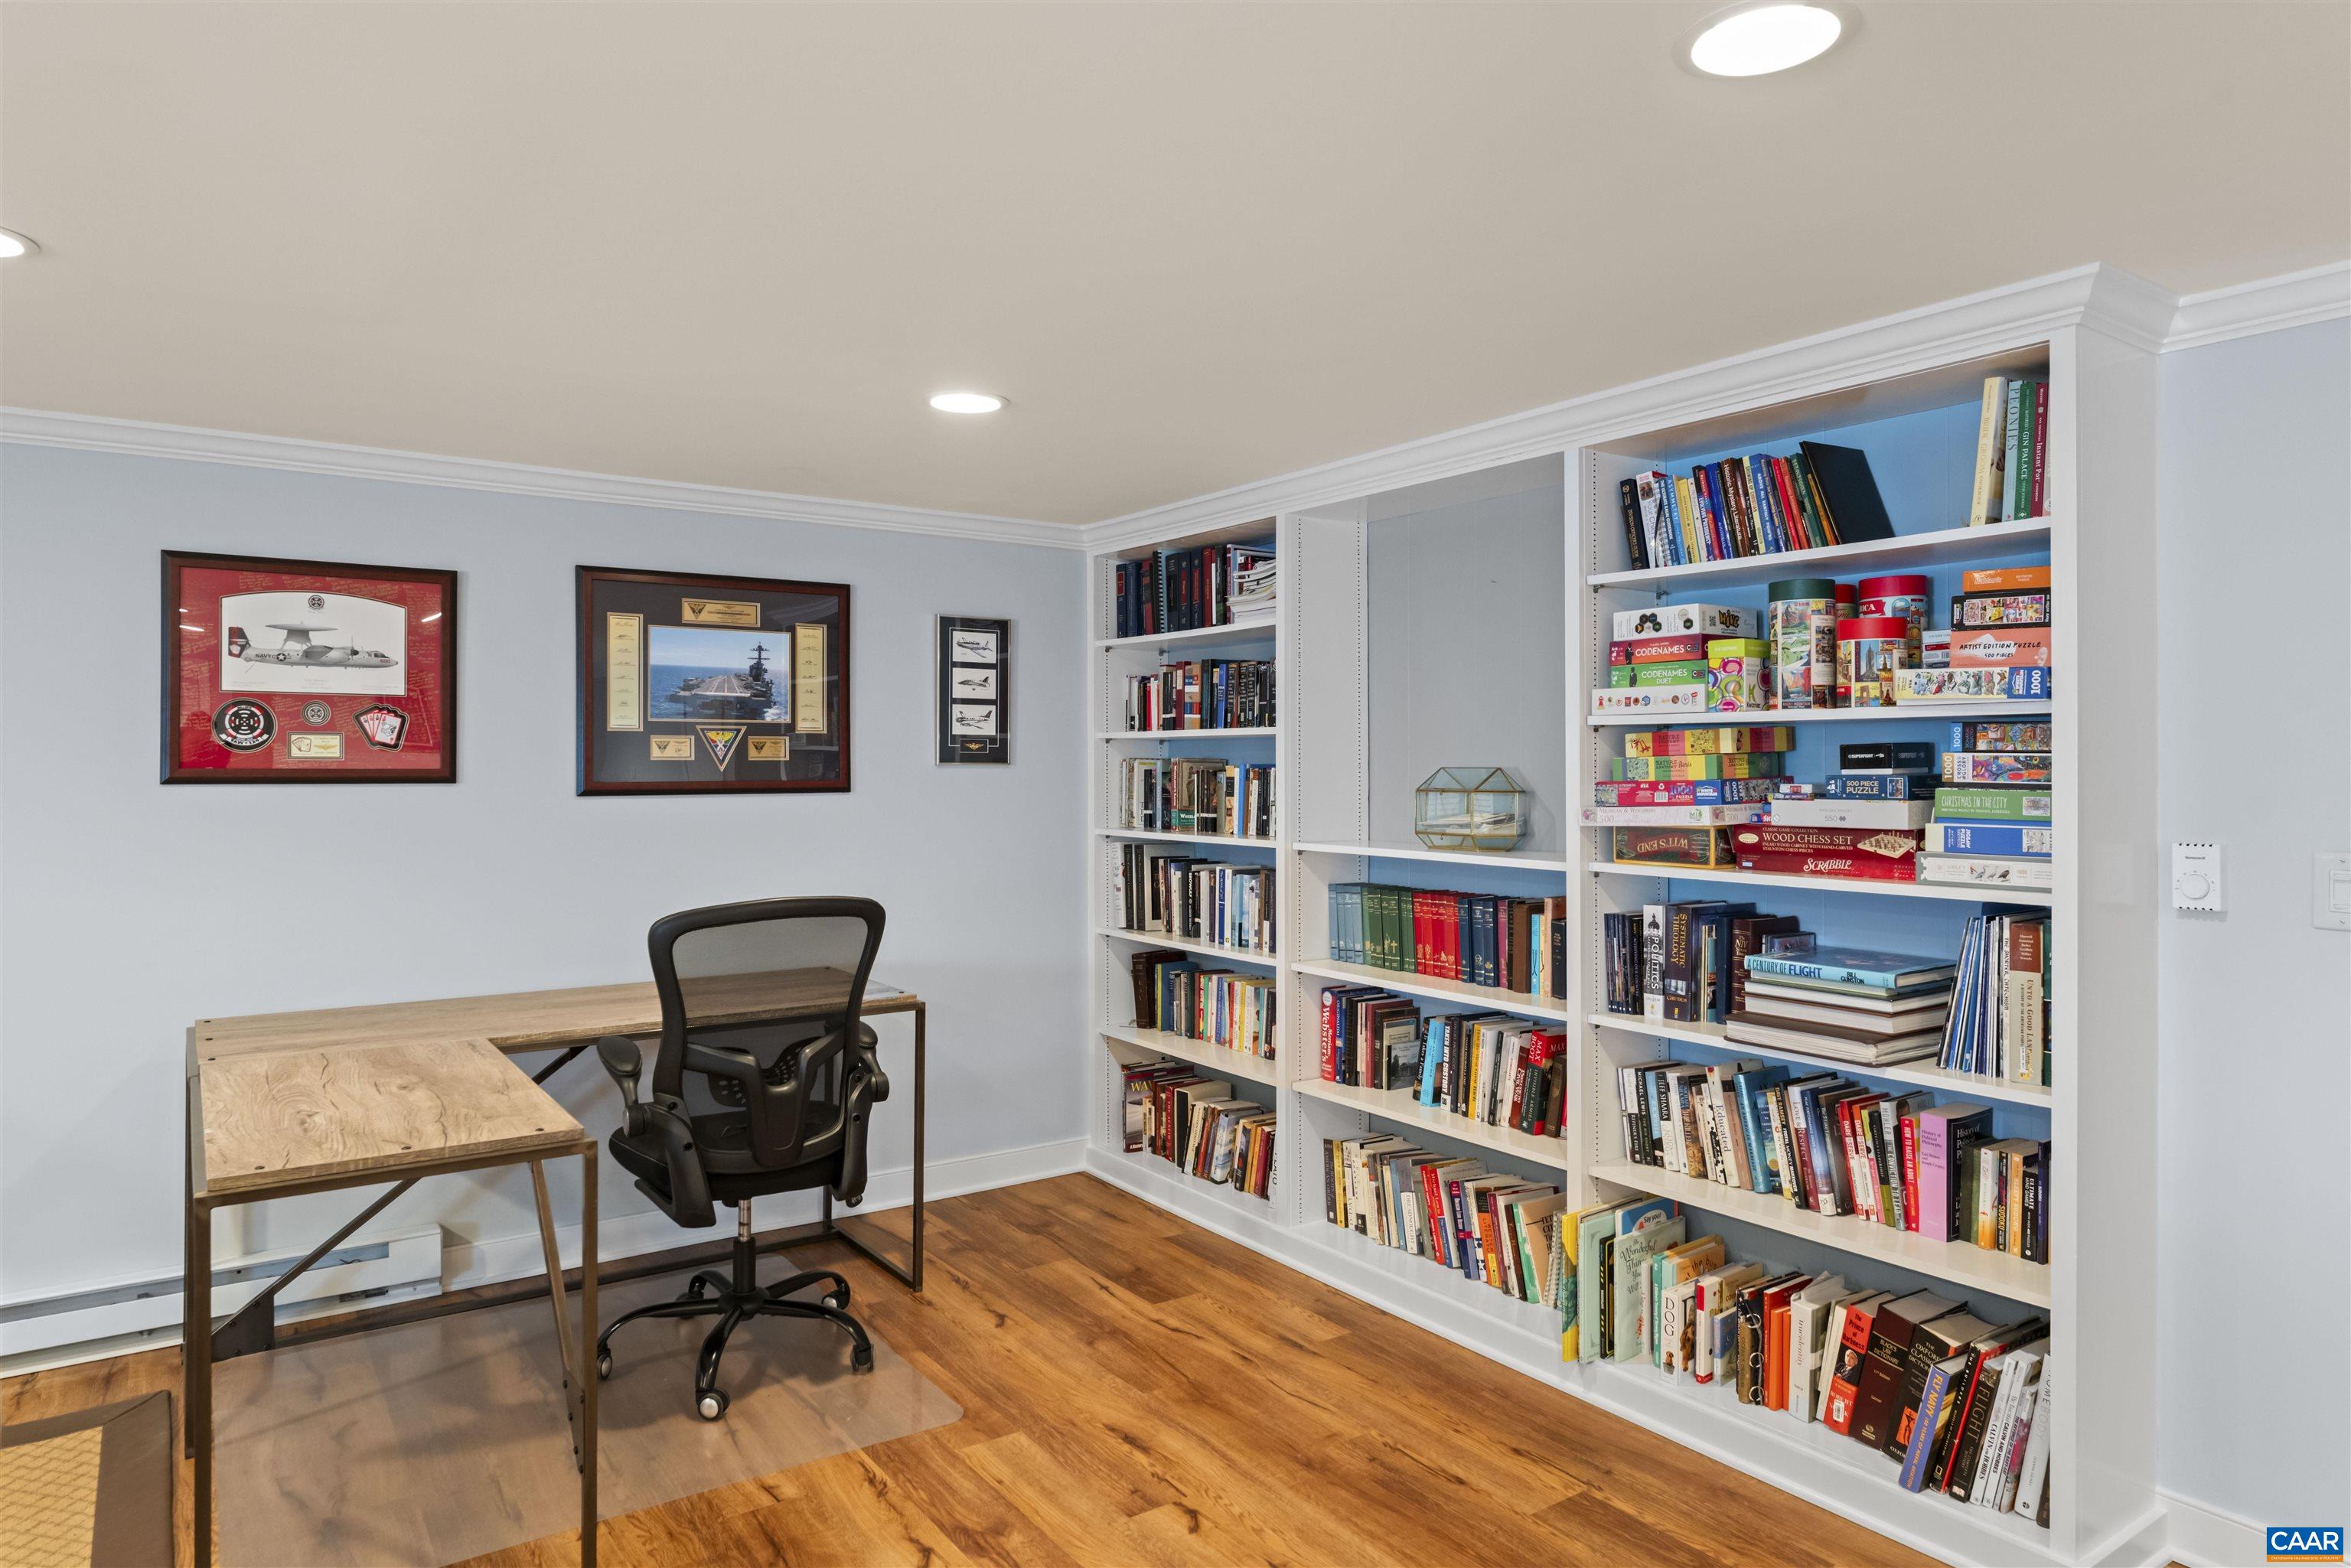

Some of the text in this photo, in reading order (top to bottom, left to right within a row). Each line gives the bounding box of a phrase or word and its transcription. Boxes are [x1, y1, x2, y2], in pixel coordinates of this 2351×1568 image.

[2007, 388, 2020, 451] PEONIES
[1668, 480, 1678, 520] ASYMMETRY
[1702, 518, 1710, 545] PRESIDENCY
[1733, 511, 1742, 540] Literature
[1635, 644, 1684, 657] CODENAMES
[1642, 669, 1687, 679] CODENAMES
[2031, 670, 2042, 695] 1000
[1669, 785, 1694, 796] 1000
[1942, 796, 2007, 808] CHRISTMAS IN THE CITY
[1599, 814, 1614, 823] 500
[1637, 836, 1688, 852] WIT'S END
[1762, 833, 1853, 845] WOOD CHESS SET
[1803, 858, 1853, 872] SCRABBLE
[1671, 916, 1679, 963] THEOLOGY
[1735, 939, 1747, 948] NIV
[1747, 959, 1822, 979] A CENTURY OF FLIGHT
[1841, 976, 1865, 985] GUNSTON
[1534, 1041, 1543, 1061] MAX
[1660, 1094, 1668, 1119] SHAARA
[1716, 1105, 1731, 1152] Educated
[1882, 1108, 1892, 1135] MOHLER
[1854, 1120, 1867, 1159] DARE SERVE
[1922, 1139, 1942, 1148] Philosophy
[1957, 1128, 1974, 1139] History
[1798, 1129, 1808, 1162] RESPECT
[1846, 1142, 1854, 1160] SERVE
[1746, 1143, 1756, 1170] MARRIAGE
[1785, 1146, 1798, 1192] MONEY MAKEOVER
[1888, 1154, 1897, 1188] CONVICTION
[1430, 1173, 1439, 1195] Michael
[1406, 1195, 1414, 1244] DREADNOUGHT
[1643, 1212, 1661, 1223] Say your
[1620, 1237, 1658, 1262] Wonderful
[1665, 1297, 1675, 1336] DOG
[1848, 1320, 1864, 1332] Prince
[1843, 1334, 1865, 1351] Darkness
[1880, 1339, 1897, 1352] BLACK'S
[1882, 1347, 1892, 1355] LAW
[1873, 1349, 1899, 1365] DICTIONARY
[1932, 1374, 1943, 1392] FLY
[1957, 1369, 1969, 1404] BUILDERS
[1926, 1390, 1939, 1418] NAVY
[1968, 1386, 1990, 1443] FLIGHT
[1920, 1426, 1929, 1441] YEARS
[2001, 1423, 2010, 1439] CALVIN
[1918, 1441, 1923, 1449] OF
[1978, 1423, 1998, 1481] CALVIN HOBBES
[1992, 1452, 2002, 1474] HOBBES
[1907, 1465, 1916, 1488] AVIATION
